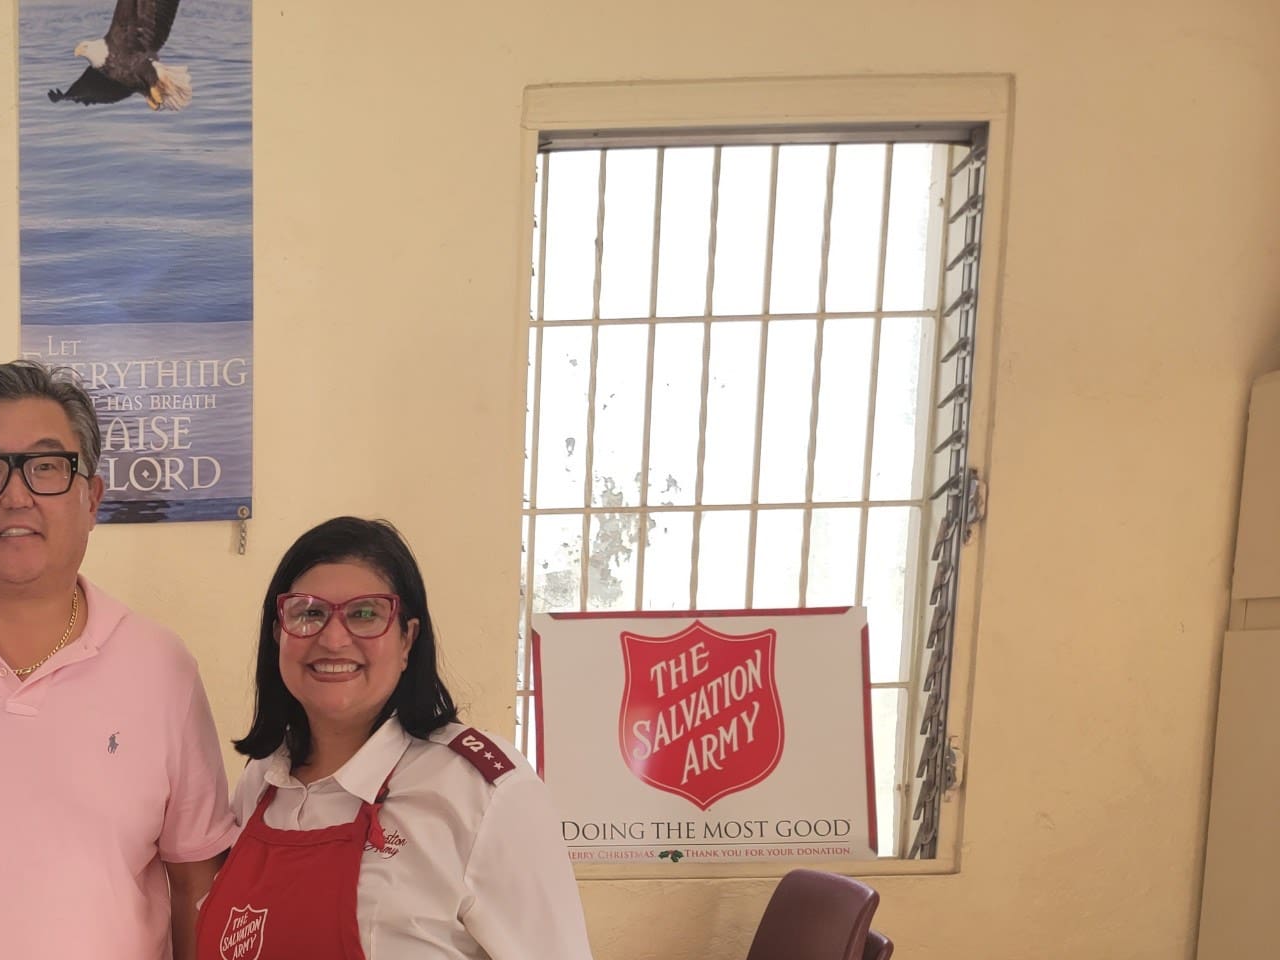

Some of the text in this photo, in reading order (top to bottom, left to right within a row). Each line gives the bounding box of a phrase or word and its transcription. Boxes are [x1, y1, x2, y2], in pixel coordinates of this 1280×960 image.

[107, 395, 143, 411] HAS
[150, 394, 217, 410] BREATH
[105, 416, 193, 451] AISE
[105, 456, 221, 491] LORD
[650, 642, 710, 698] THE
[632, 649, 763, 761] SALVATION
[680, 701, 761, 785] ARMY
[561, 819, 851, 841] DOING THE MOST GOOD
[222, 916, 262, 952] SALVATION
[232, 912, 249, 931] THE
[232, 934, 257, 960] ARMY
